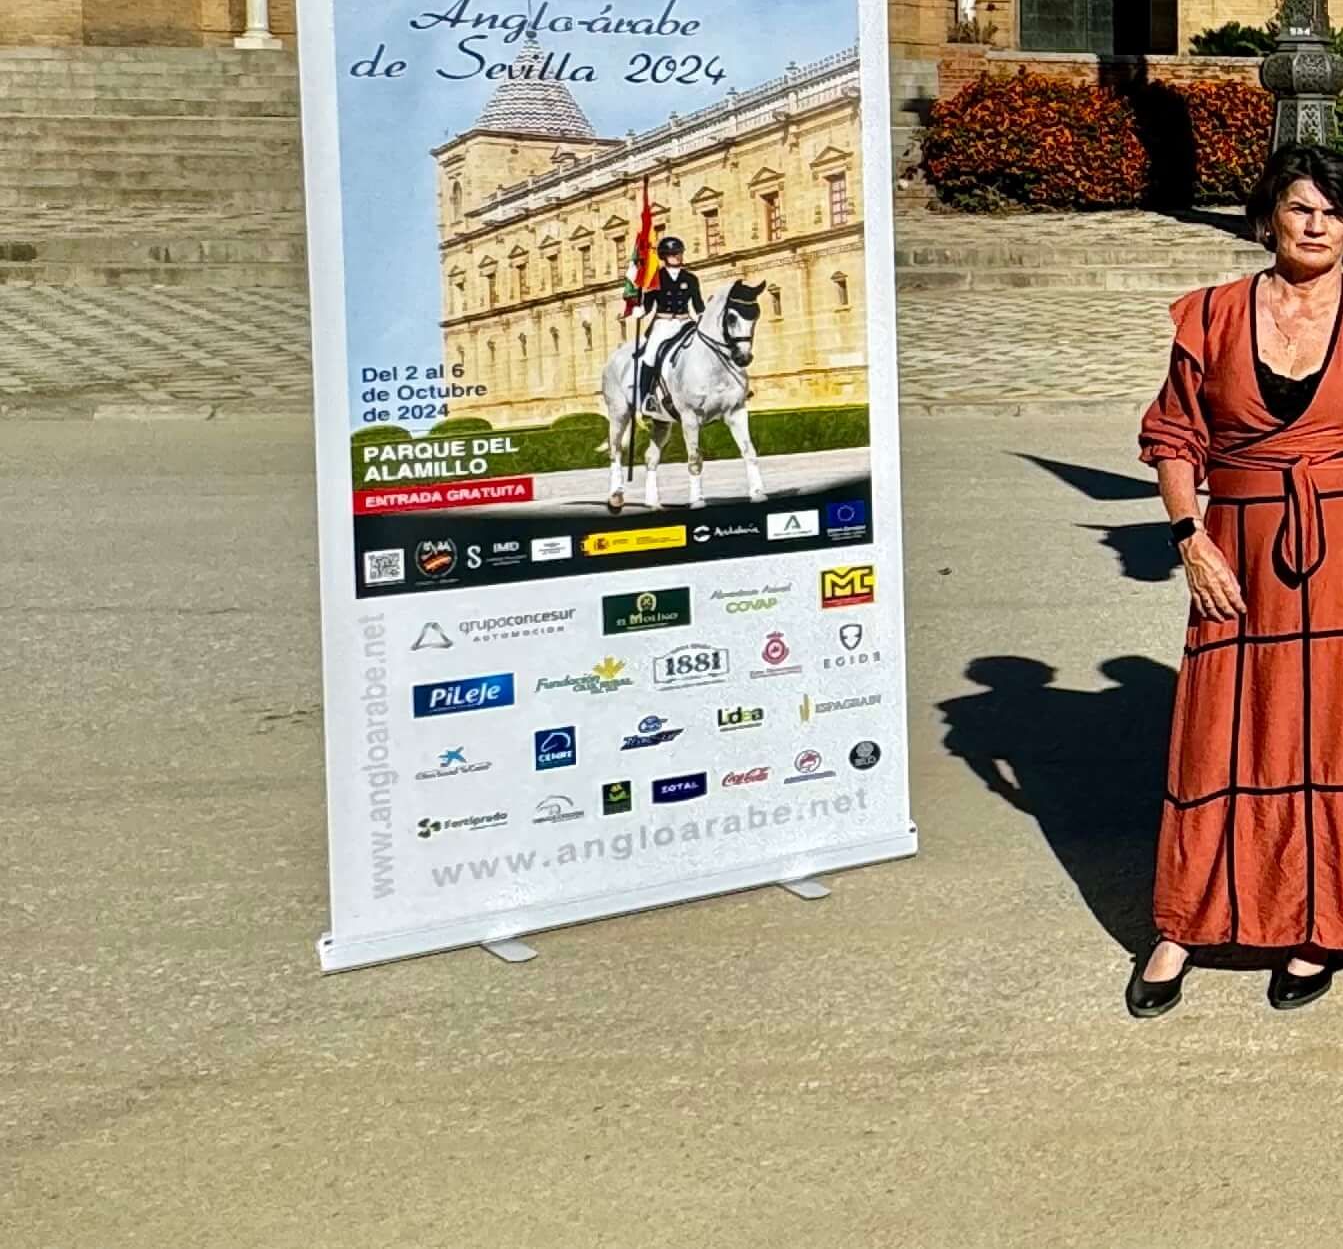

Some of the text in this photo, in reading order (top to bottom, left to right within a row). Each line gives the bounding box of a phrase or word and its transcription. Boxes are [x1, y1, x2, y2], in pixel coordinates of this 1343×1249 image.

[350, 35, 727, 85] de Sevilla 2024
[362, 364, 465, 383] Del 2 al 6
[362, 383, 488, 403] de Octubre
[363, 404, 450, 422] de 2024
[363, 437, 520, 463] PARQUE DEL
[363, 458, 488, 482] ALAMILLO
[365, 484, 525, 508] ENTRADA GRATUITA
[726, 598, 778, 614] COVAP
[459, 608, 576, 635] grupoconcesur
[666, 652, 721, 676] 1881
[429, 682, 501, 708] PiLeJe
[359, 612, 398, 900] www.angloarabe.net
[432, 788, 868, 888] www.angloarabe.net
